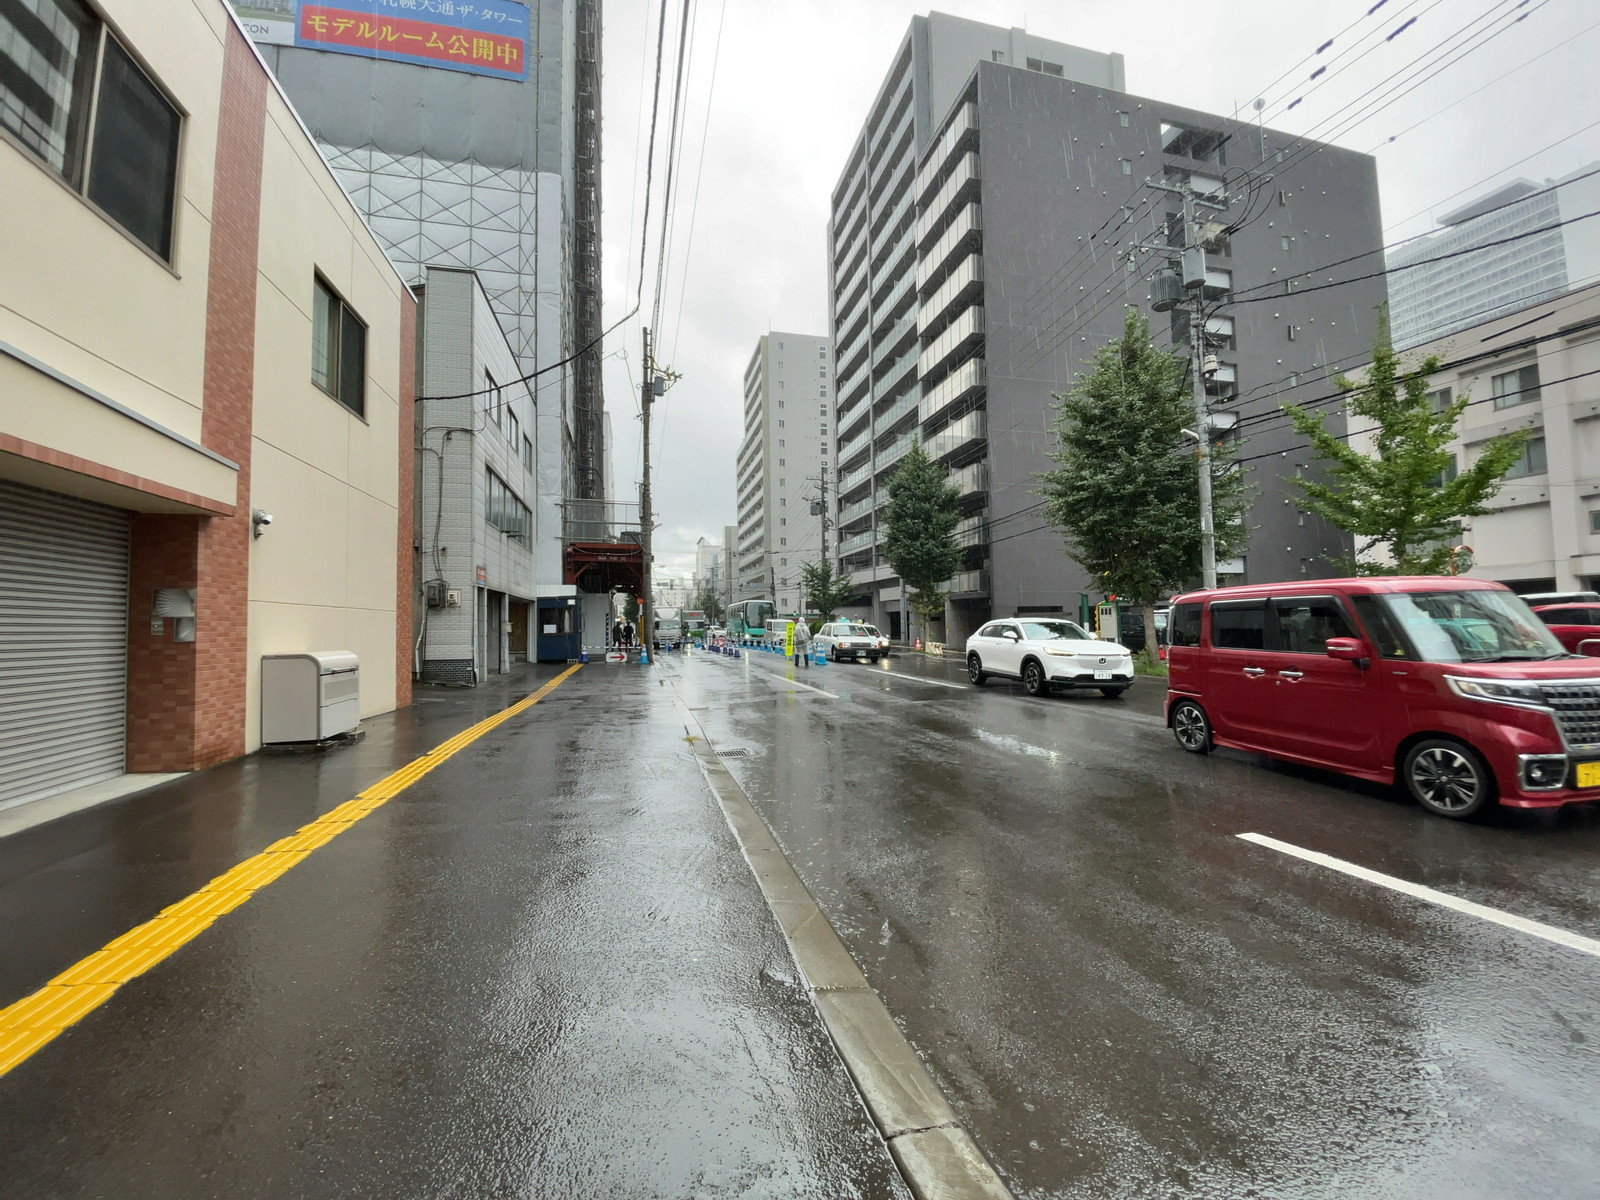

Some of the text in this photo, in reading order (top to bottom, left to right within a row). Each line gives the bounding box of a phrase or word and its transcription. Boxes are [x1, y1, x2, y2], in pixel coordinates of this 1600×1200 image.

[307, 15, 518, 65] モデルルーム公開中
